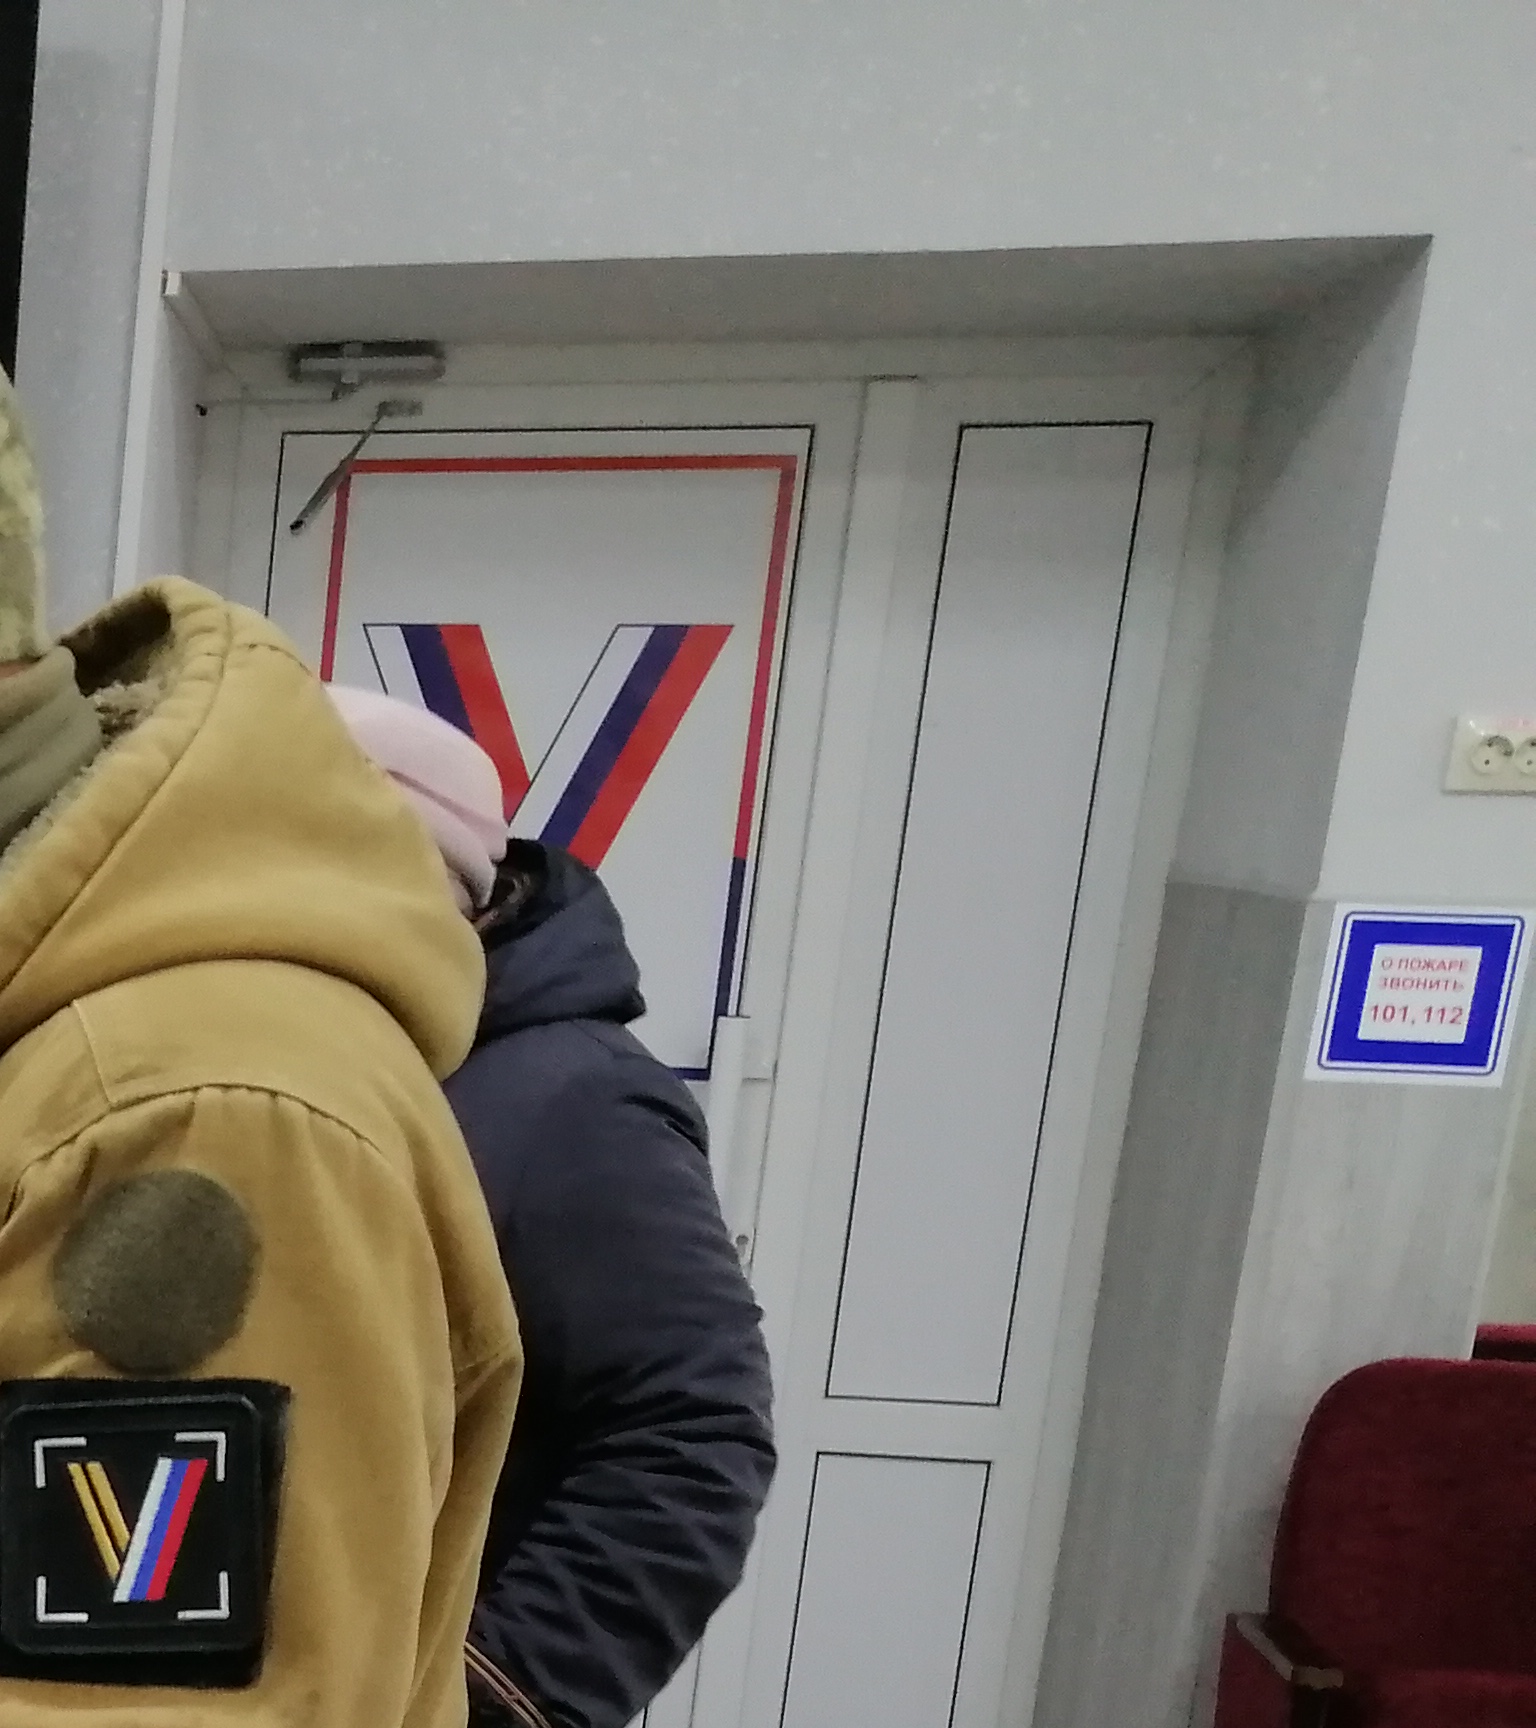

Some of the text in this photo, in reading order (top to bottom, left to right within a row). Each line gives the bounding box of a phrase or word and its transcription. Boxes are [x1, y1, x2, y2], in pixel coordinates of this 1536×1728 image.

[1380, 957, 1468, 973] О ПОЖАРЕ
[1378, 977, 1465, 992] ЗВОНИТЬ
[1371, 1004, 1463, 1025] 101, 112
